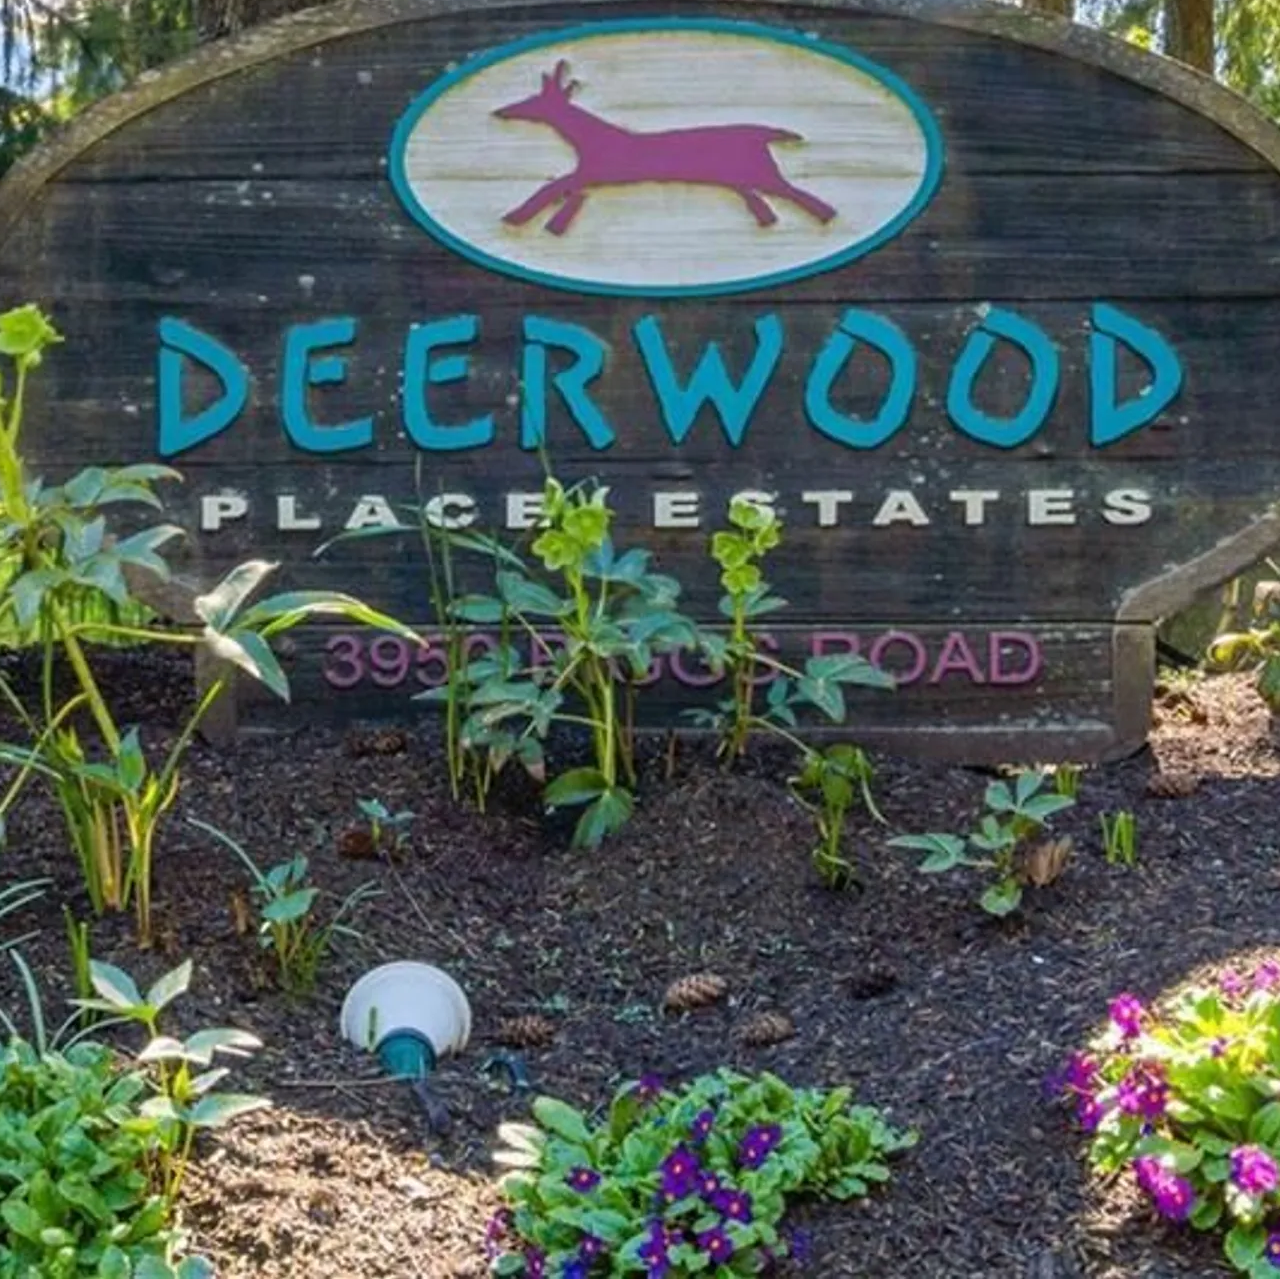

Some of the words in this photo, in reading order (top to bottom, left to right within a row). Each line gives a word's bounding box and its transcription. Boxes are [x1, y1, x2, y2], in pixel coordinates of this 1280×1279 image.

[158, 301, 1185, 457] DEERWOOD
[200, 493, 552, 531] PLACE
[653, 489, 1153, 527] ESTATES
